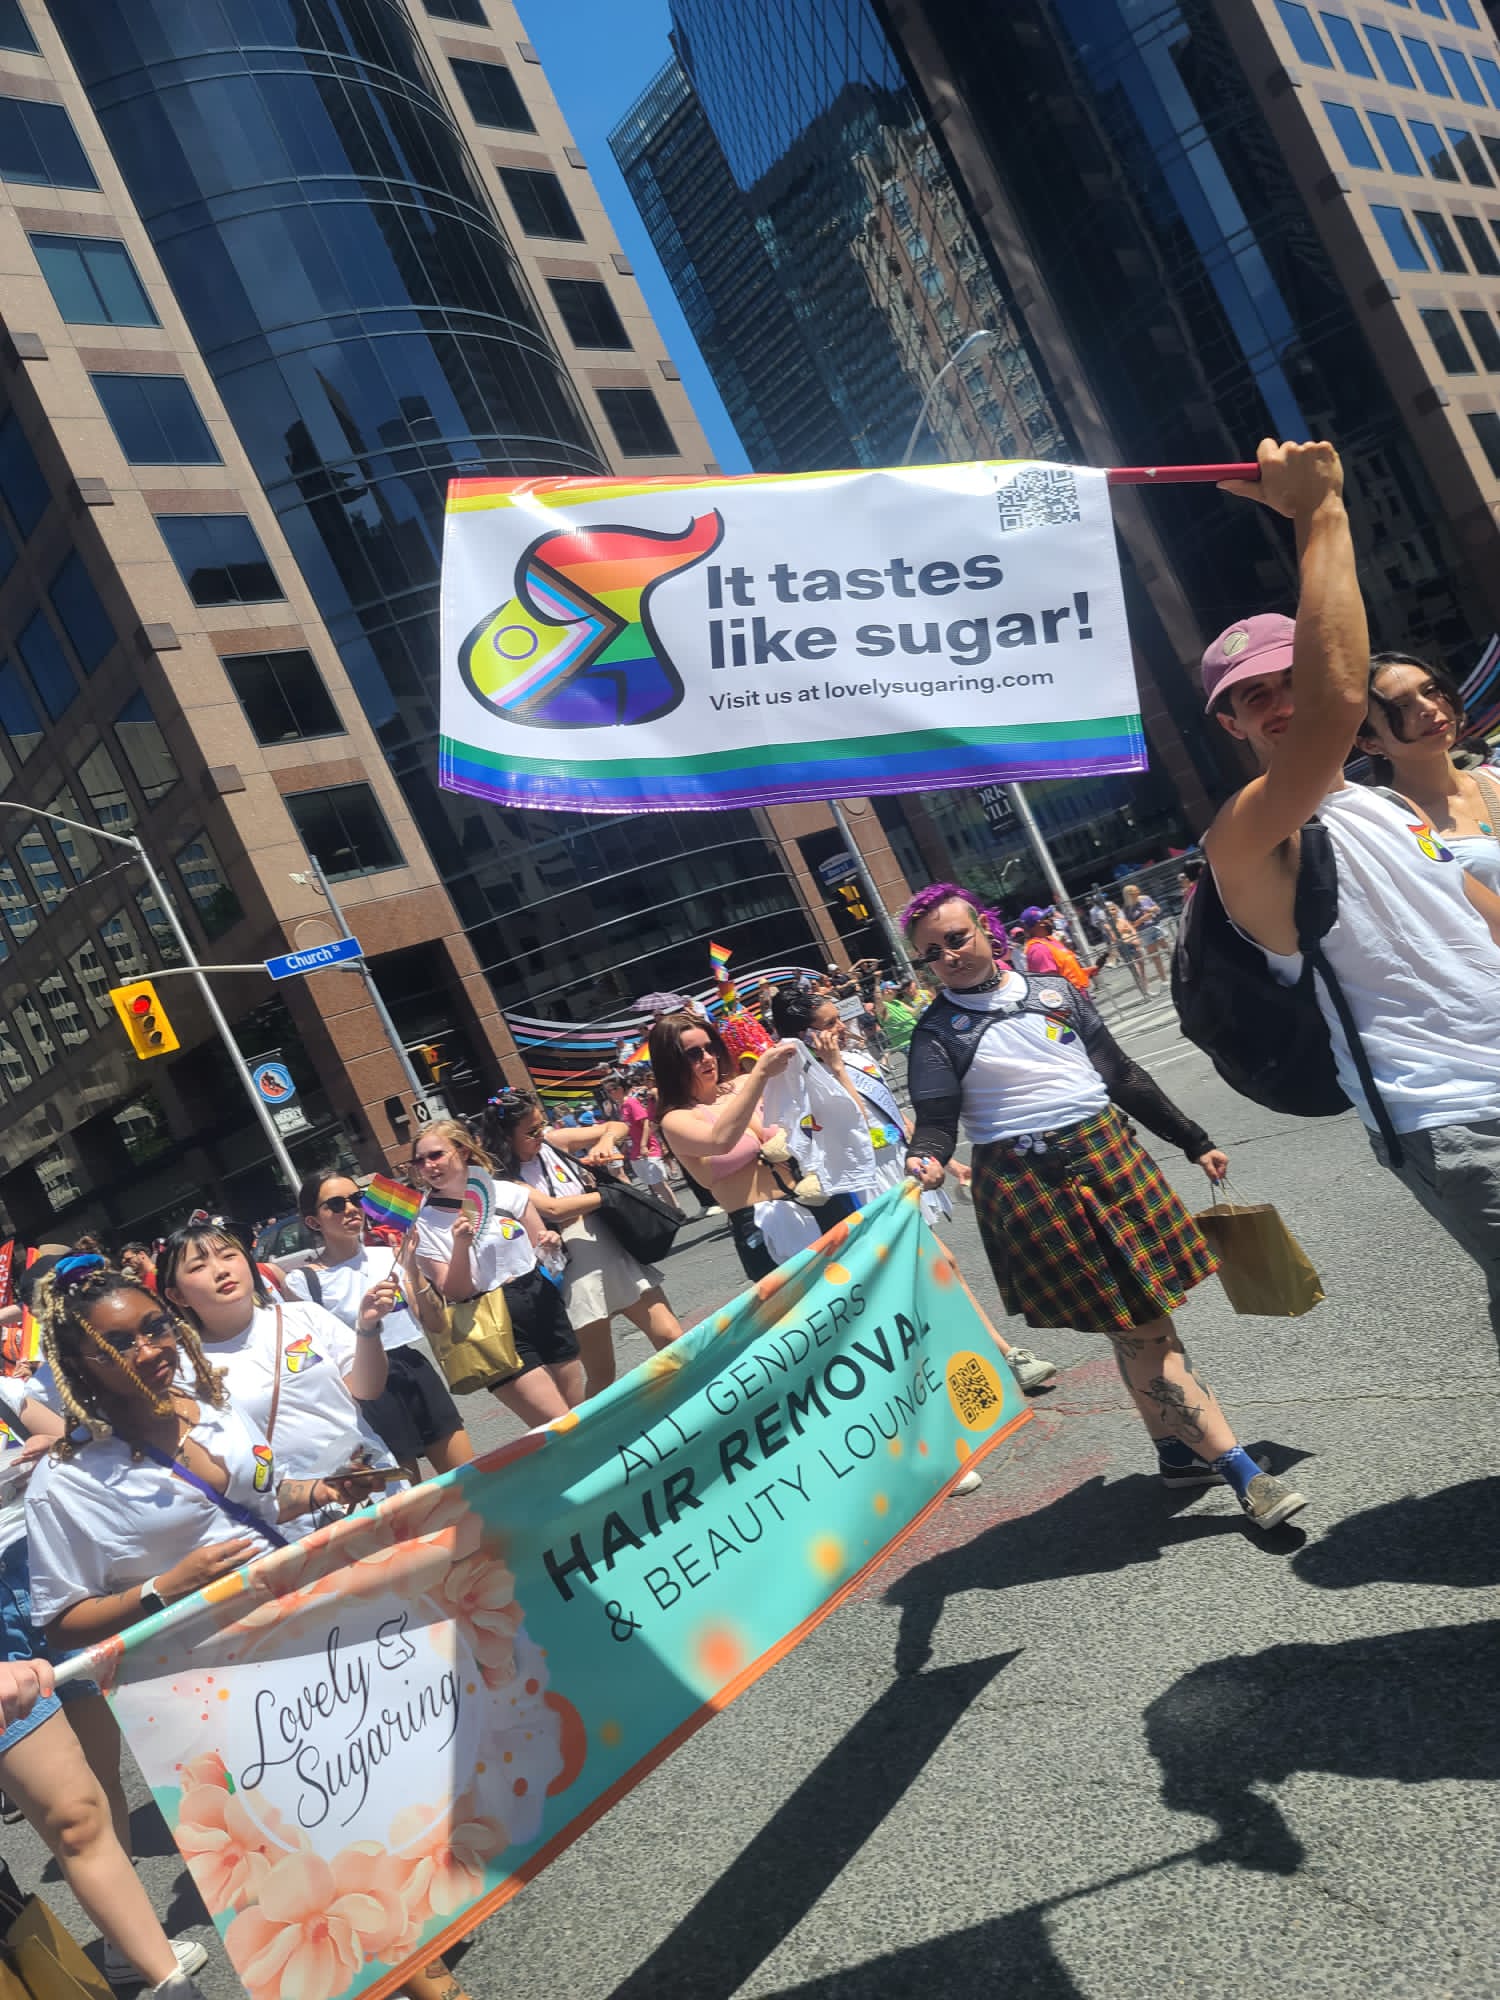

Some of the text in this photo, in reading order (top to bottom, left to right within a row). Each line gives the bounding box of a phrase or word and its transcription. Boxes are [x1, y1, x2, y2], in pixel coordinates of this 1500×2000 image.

[707, 554, 1004, 609] It tastes
[709, 591, 1093, 669] like sugar!
[710, 670, 1054, 711] Visit us at lovelysugaring.com
[286, 949, 333, 969] Church
[543, 1311, 931, 1601] HAIR REMOVAL
[617, 1283, 866, 1484] ALL GENDERS
[604, 1357, 943, 1642] & BEAUTY LOUNGE
[240, 1626, 370, 1790] Lovely
[296, 1671, 460, 1828] Sugaring
